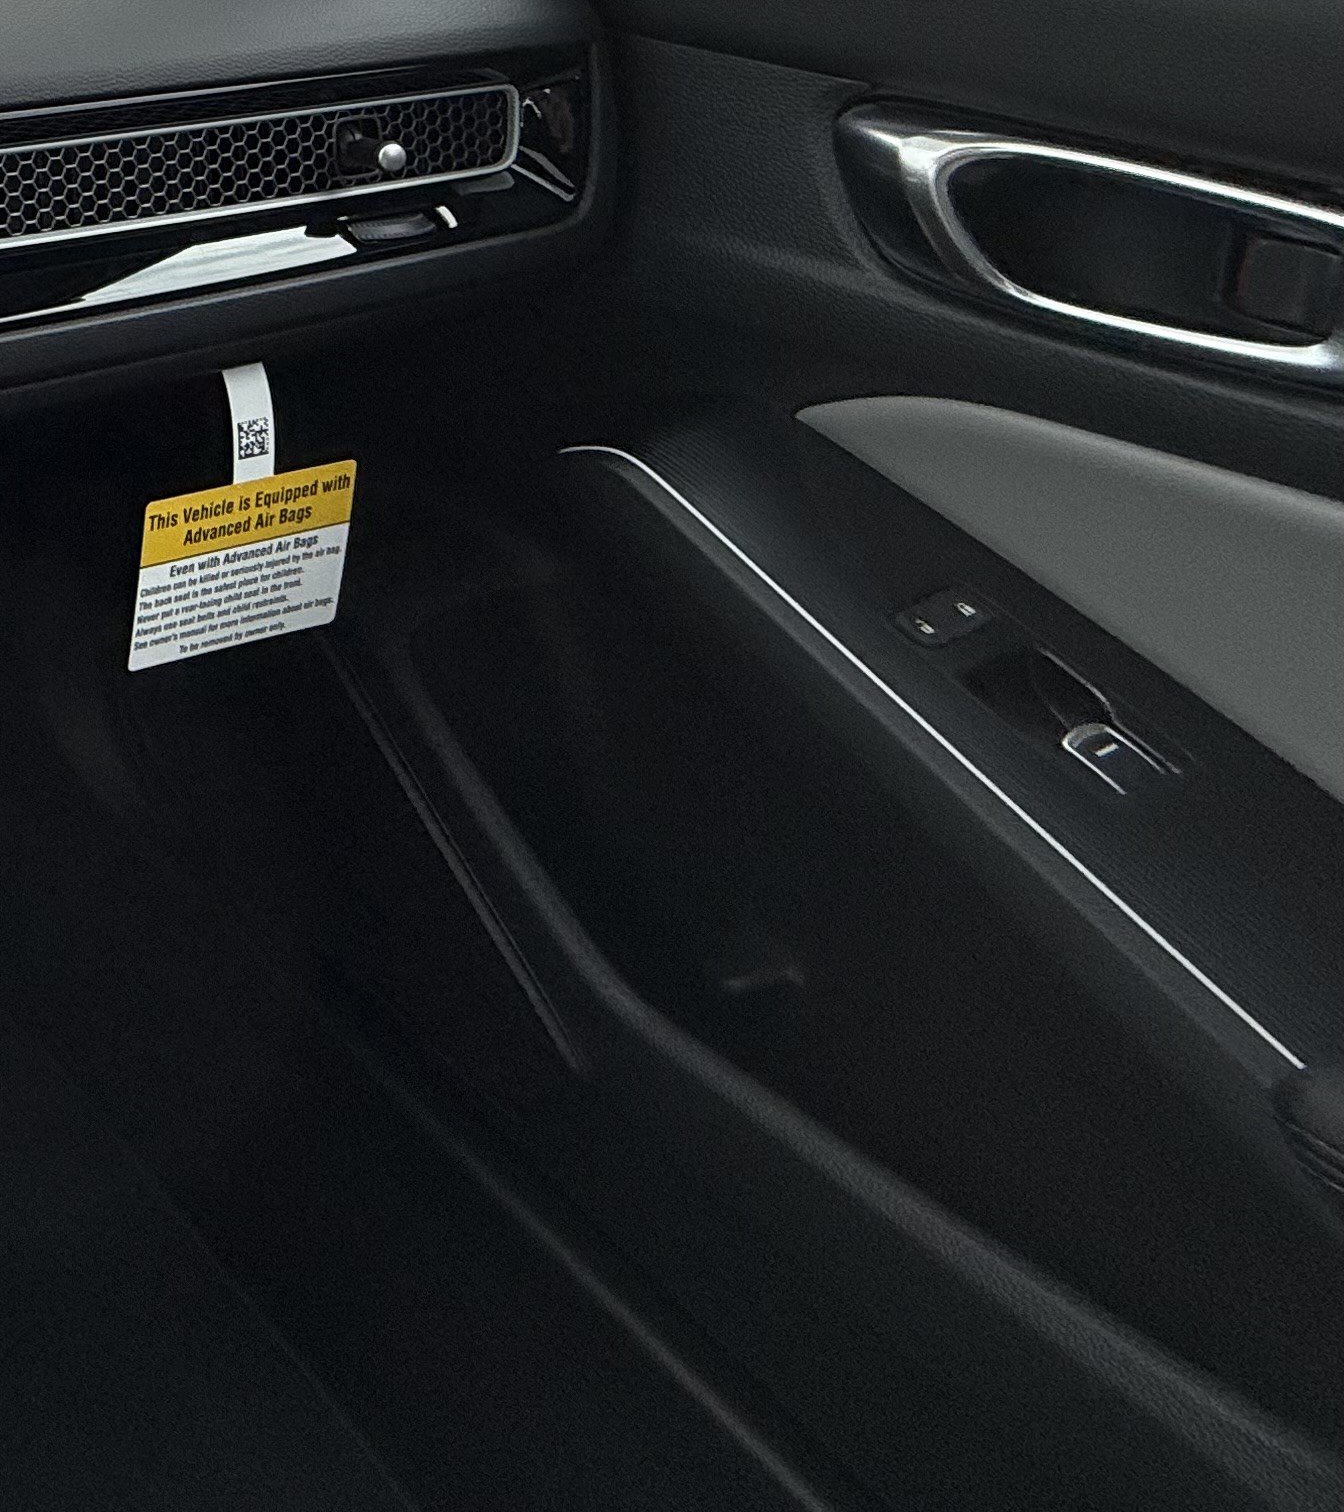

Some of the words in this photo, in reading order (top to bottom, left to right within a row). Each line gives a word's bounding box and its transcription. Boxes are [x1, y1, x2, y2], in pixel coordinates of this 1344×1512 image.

[148, 511, 179, 532] This
[183, 498, 235, 524] Vehicle
[238, 495, 251, 512] is
[254, 479, 319, 509] Equipped
[321, 473, 351, 494] with
[183, 516, 252, 546] Advanced
[254, 512, 275, 530] Air
[278, 505, 313, 525] Bags
[169, 563, 195, 578] Even
[197, 555, 221, 571] with
[222, 543, 273, 566] Advanced
[274, 540, 291, 554] Air
[292, 535, 319, 550] Bags
